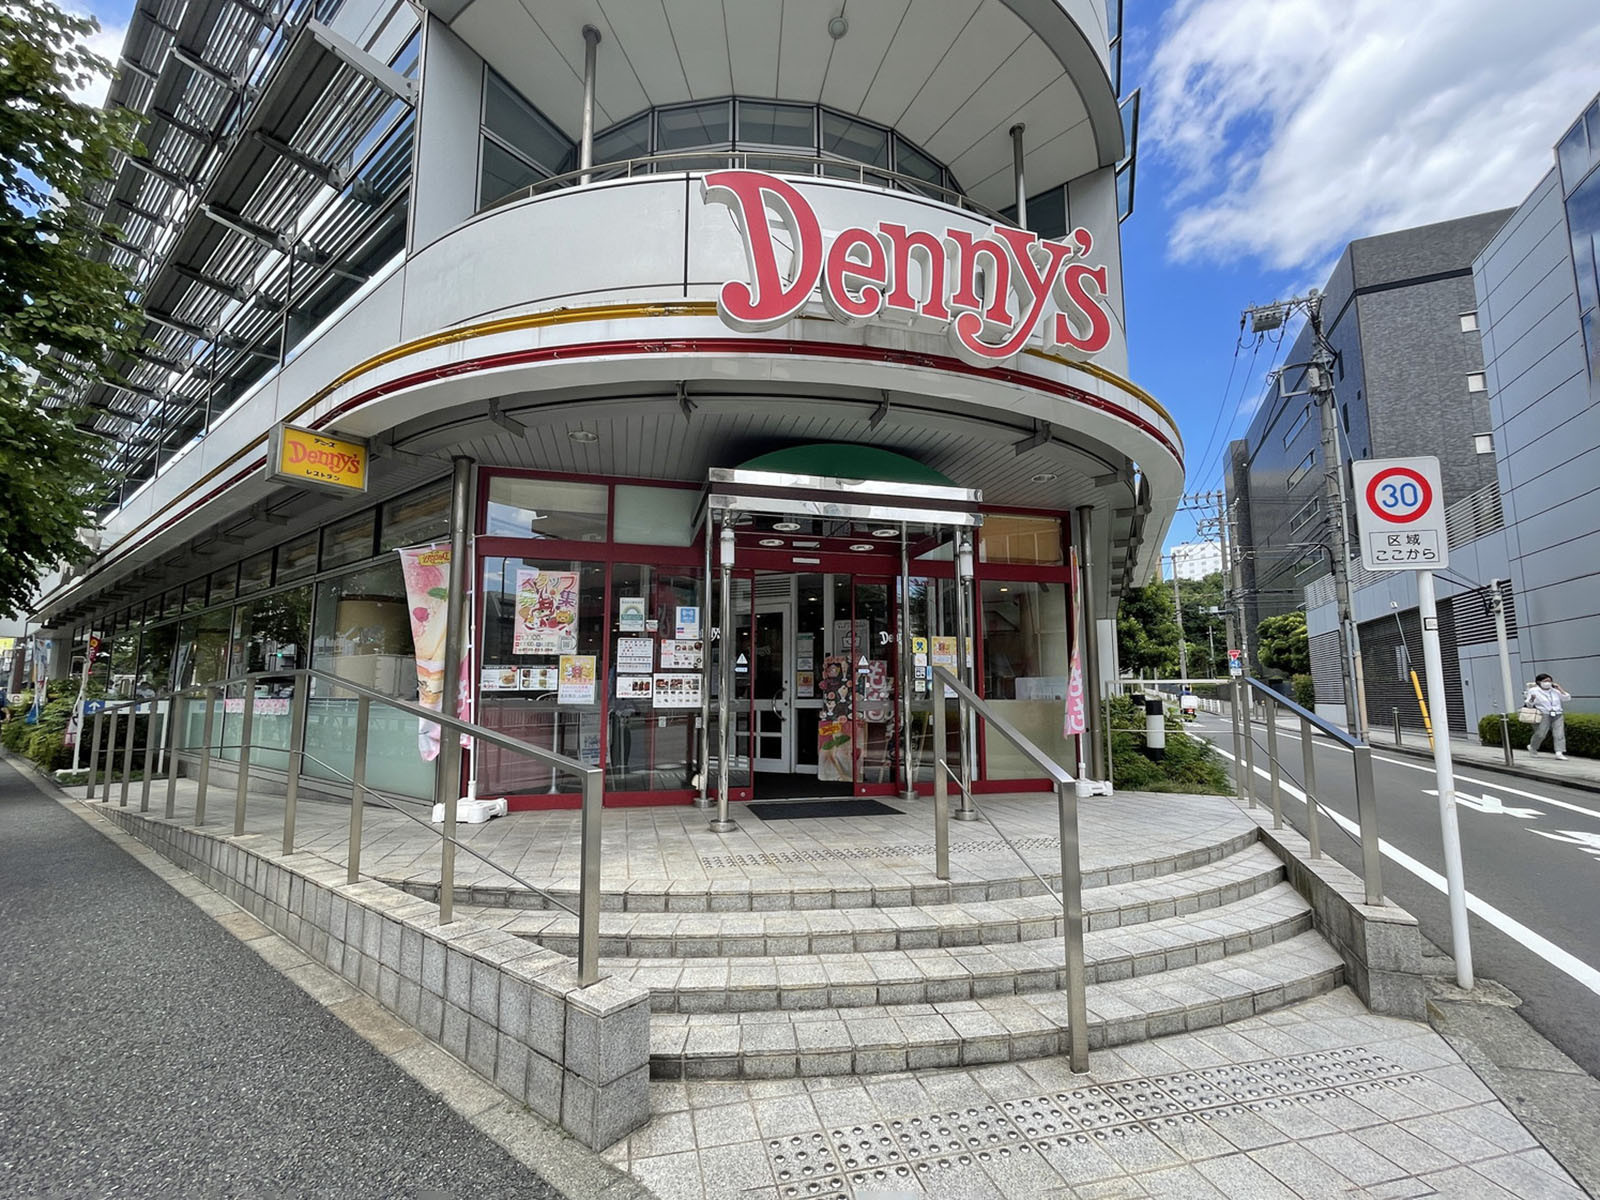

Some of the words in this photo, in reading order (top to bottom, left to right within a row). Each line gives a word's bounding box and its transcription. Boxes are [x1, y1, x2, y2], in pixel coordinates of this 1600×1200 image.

[702, 168, 1111, 367] Denny's
[287, 440, 360, 474] Denny's
[306, 469, 341, 481] レストラン
[1381, 482, 1418, 508] 30
[1387, 533, 1421, 547] 区域
[1375, 548, 1436, 562] ここから
